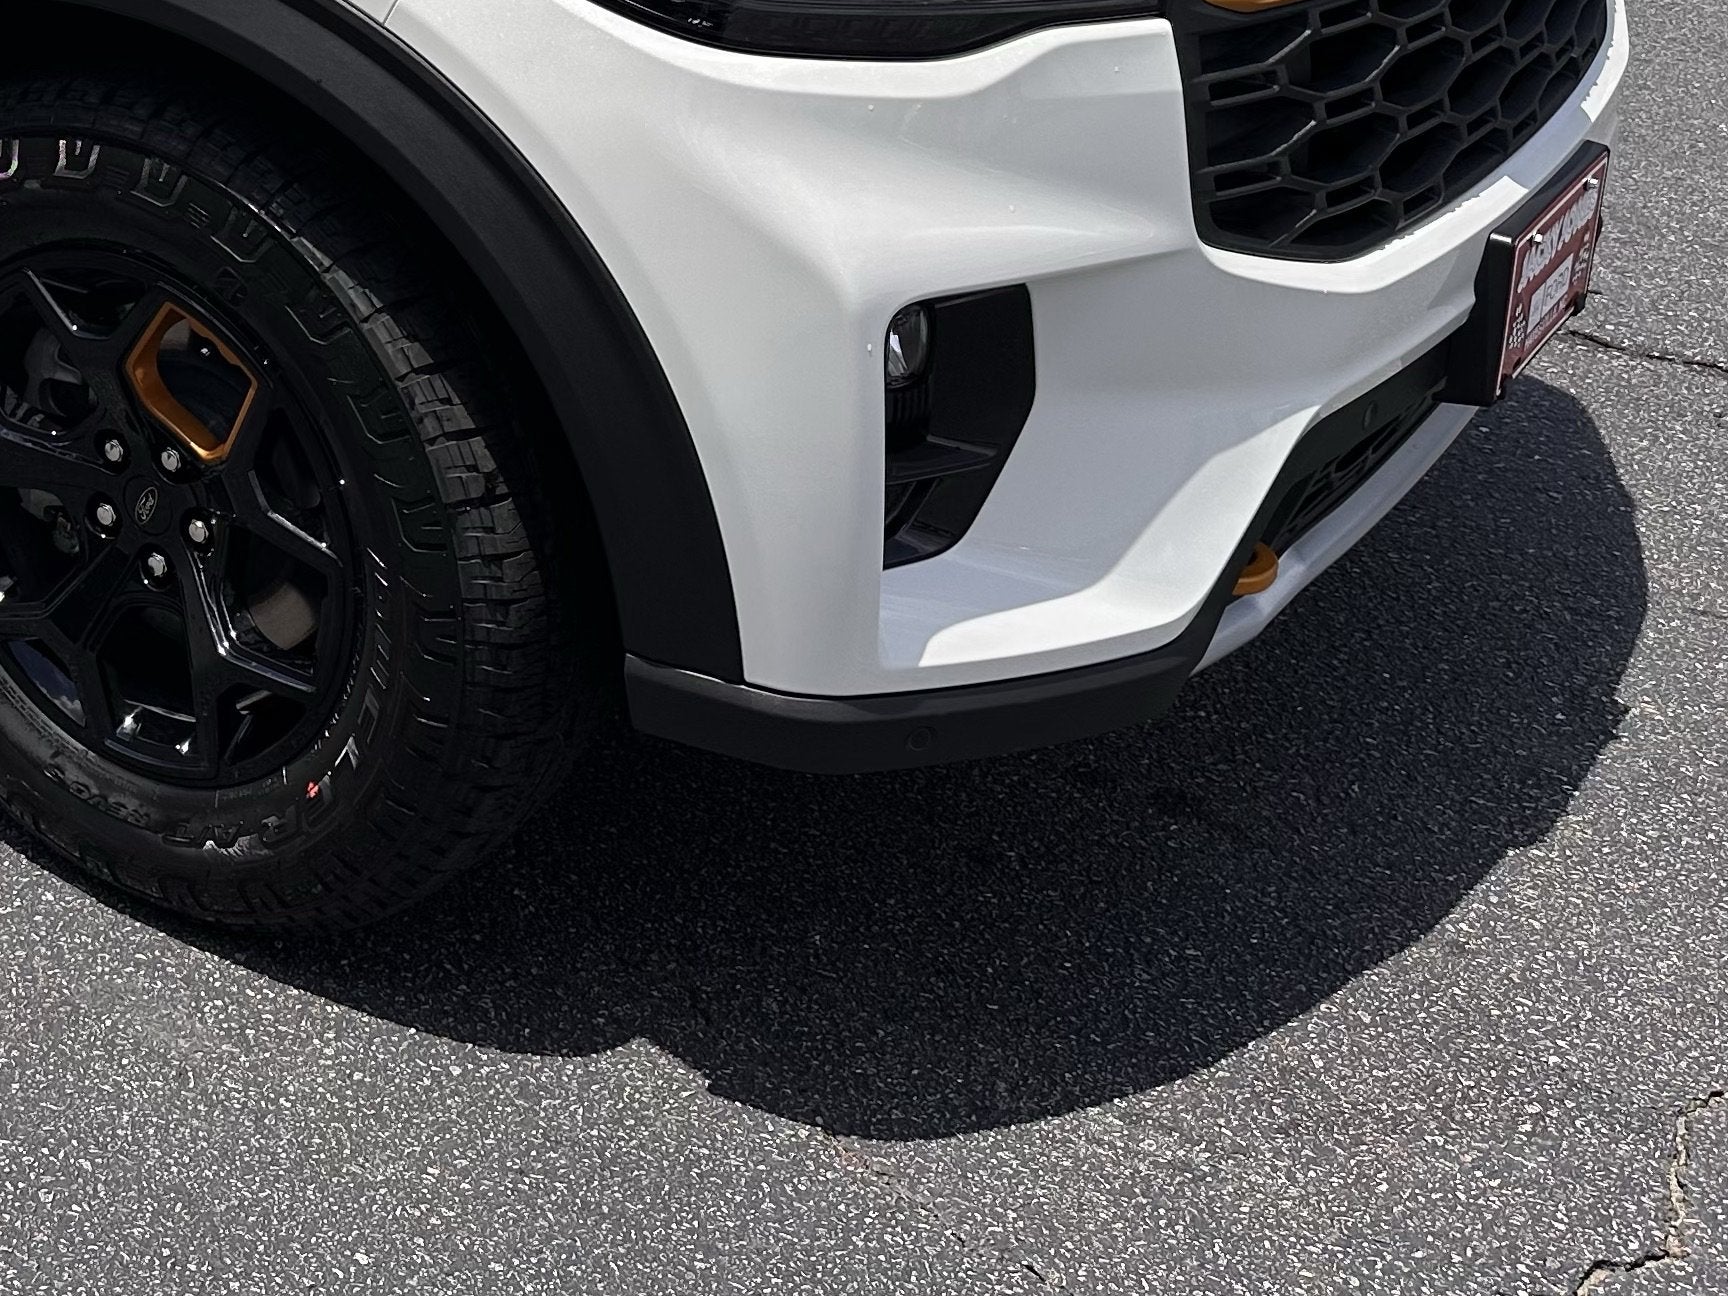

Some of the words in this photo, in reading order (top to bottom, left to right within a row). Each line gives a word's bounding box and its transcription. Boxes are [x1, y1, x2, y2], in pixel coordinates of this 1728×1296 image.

[1517, 215, 1565, 293] JACKY
[1546, 265, 1570, 303] FORD
[138, 491, 155, 522] Ford
